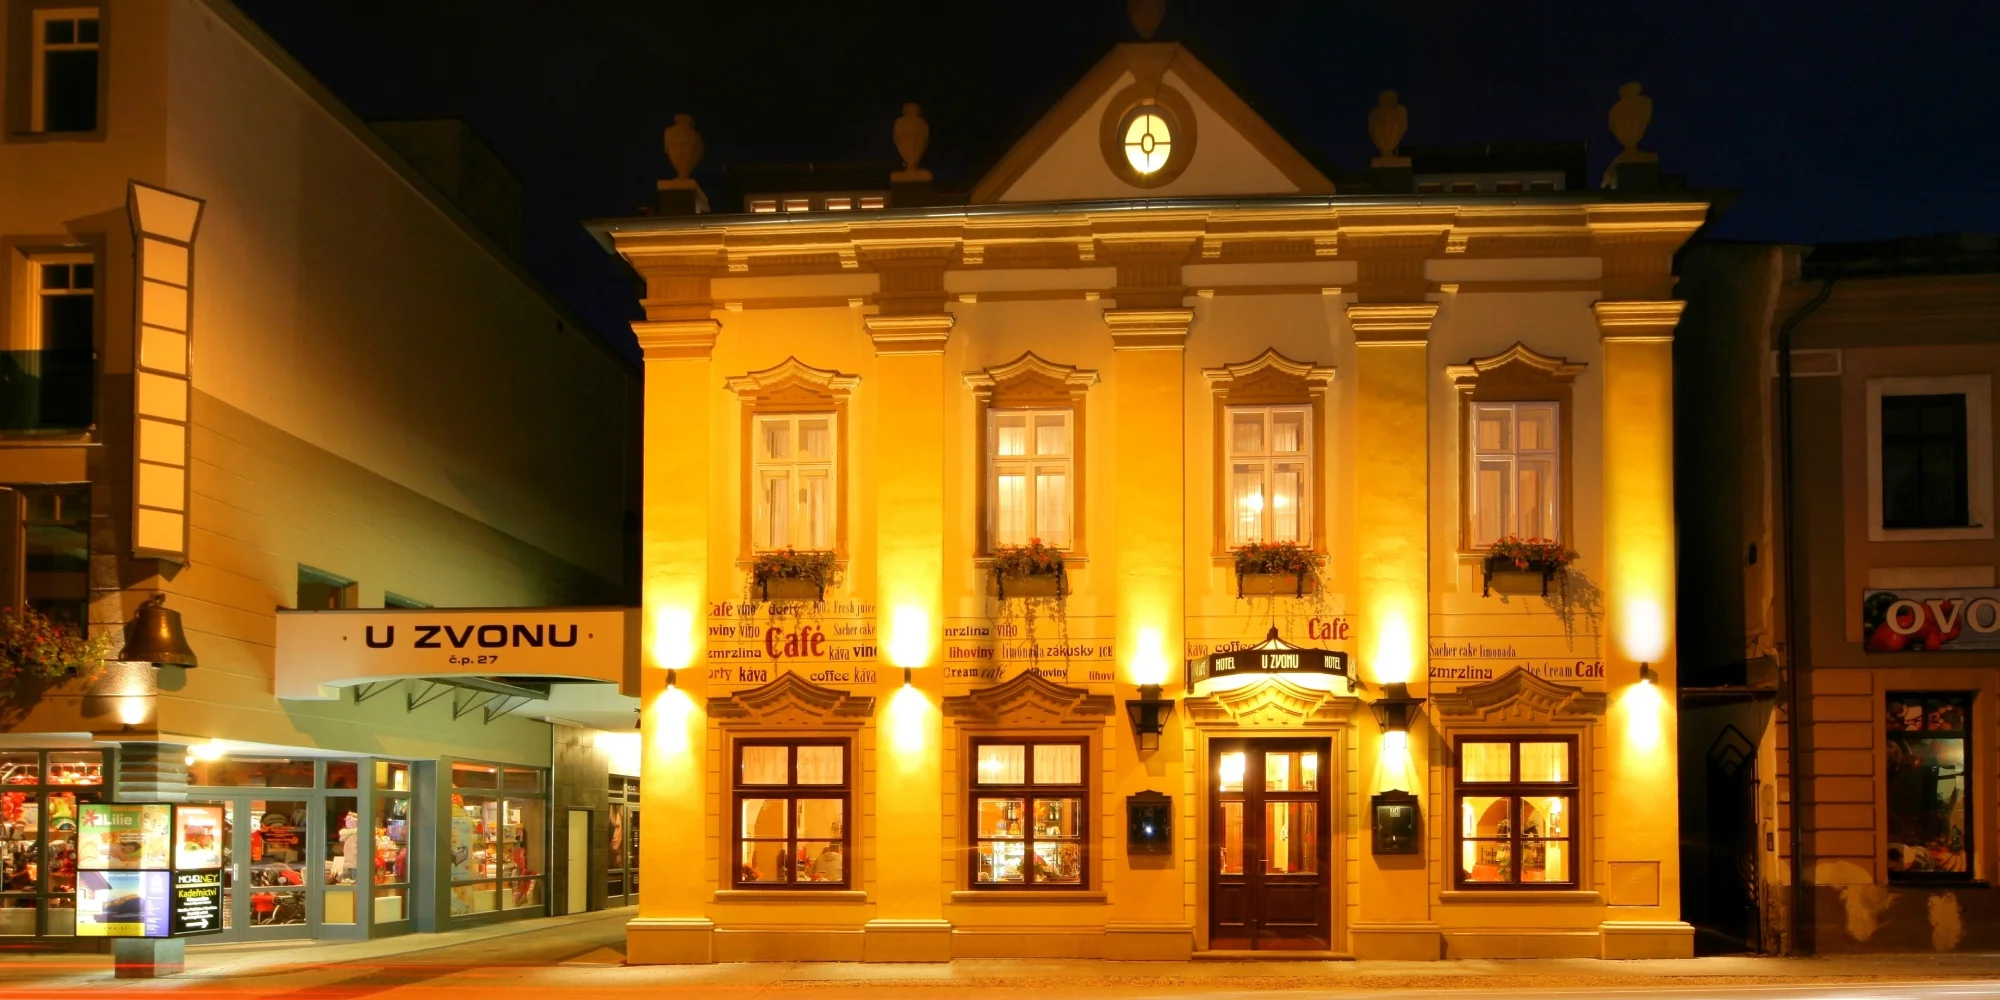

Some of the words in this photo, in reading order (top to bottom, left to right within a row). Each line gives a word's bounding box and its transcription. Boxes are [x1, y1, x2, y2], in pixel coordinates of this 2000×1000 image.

[1886, 598, 2000, 635] OVO
[366, 625, 394, 648] U
[414, 624, 578, 648] ZVONU
[1308, 617, 1349, 640] Café
[766, 625, 826, 659] Café
[1187, 642, 1208, 656] káva
[1430, 642, 1458, 657] Sacher
[1459, 642, 1477, 657] cake
[708, 648, 762, 658] zmrzlina
[830, 645, 850, 660] káva
[949, 646, 994, 660] lihoviny
[1047, 644, 1094, 657] zákusky
[1098, 646, 1112, 657] ICE
[448, 654, 474, 666] č.p.
[477, 655, 498, 664] 27
[1216, 657, 1236, 672] HOTEL
[1261, 654, 1268, 669] U
[1270, 654, 1299, 669] ZVONU
[1324, 656, 1341, 670] HOTEL
[739, 666, 767, 682] káva
[810, 669, 849, 682] coffee
[854, 666, 876, 682] káva
[1429, 665, 1492, 679] zmrzlina
